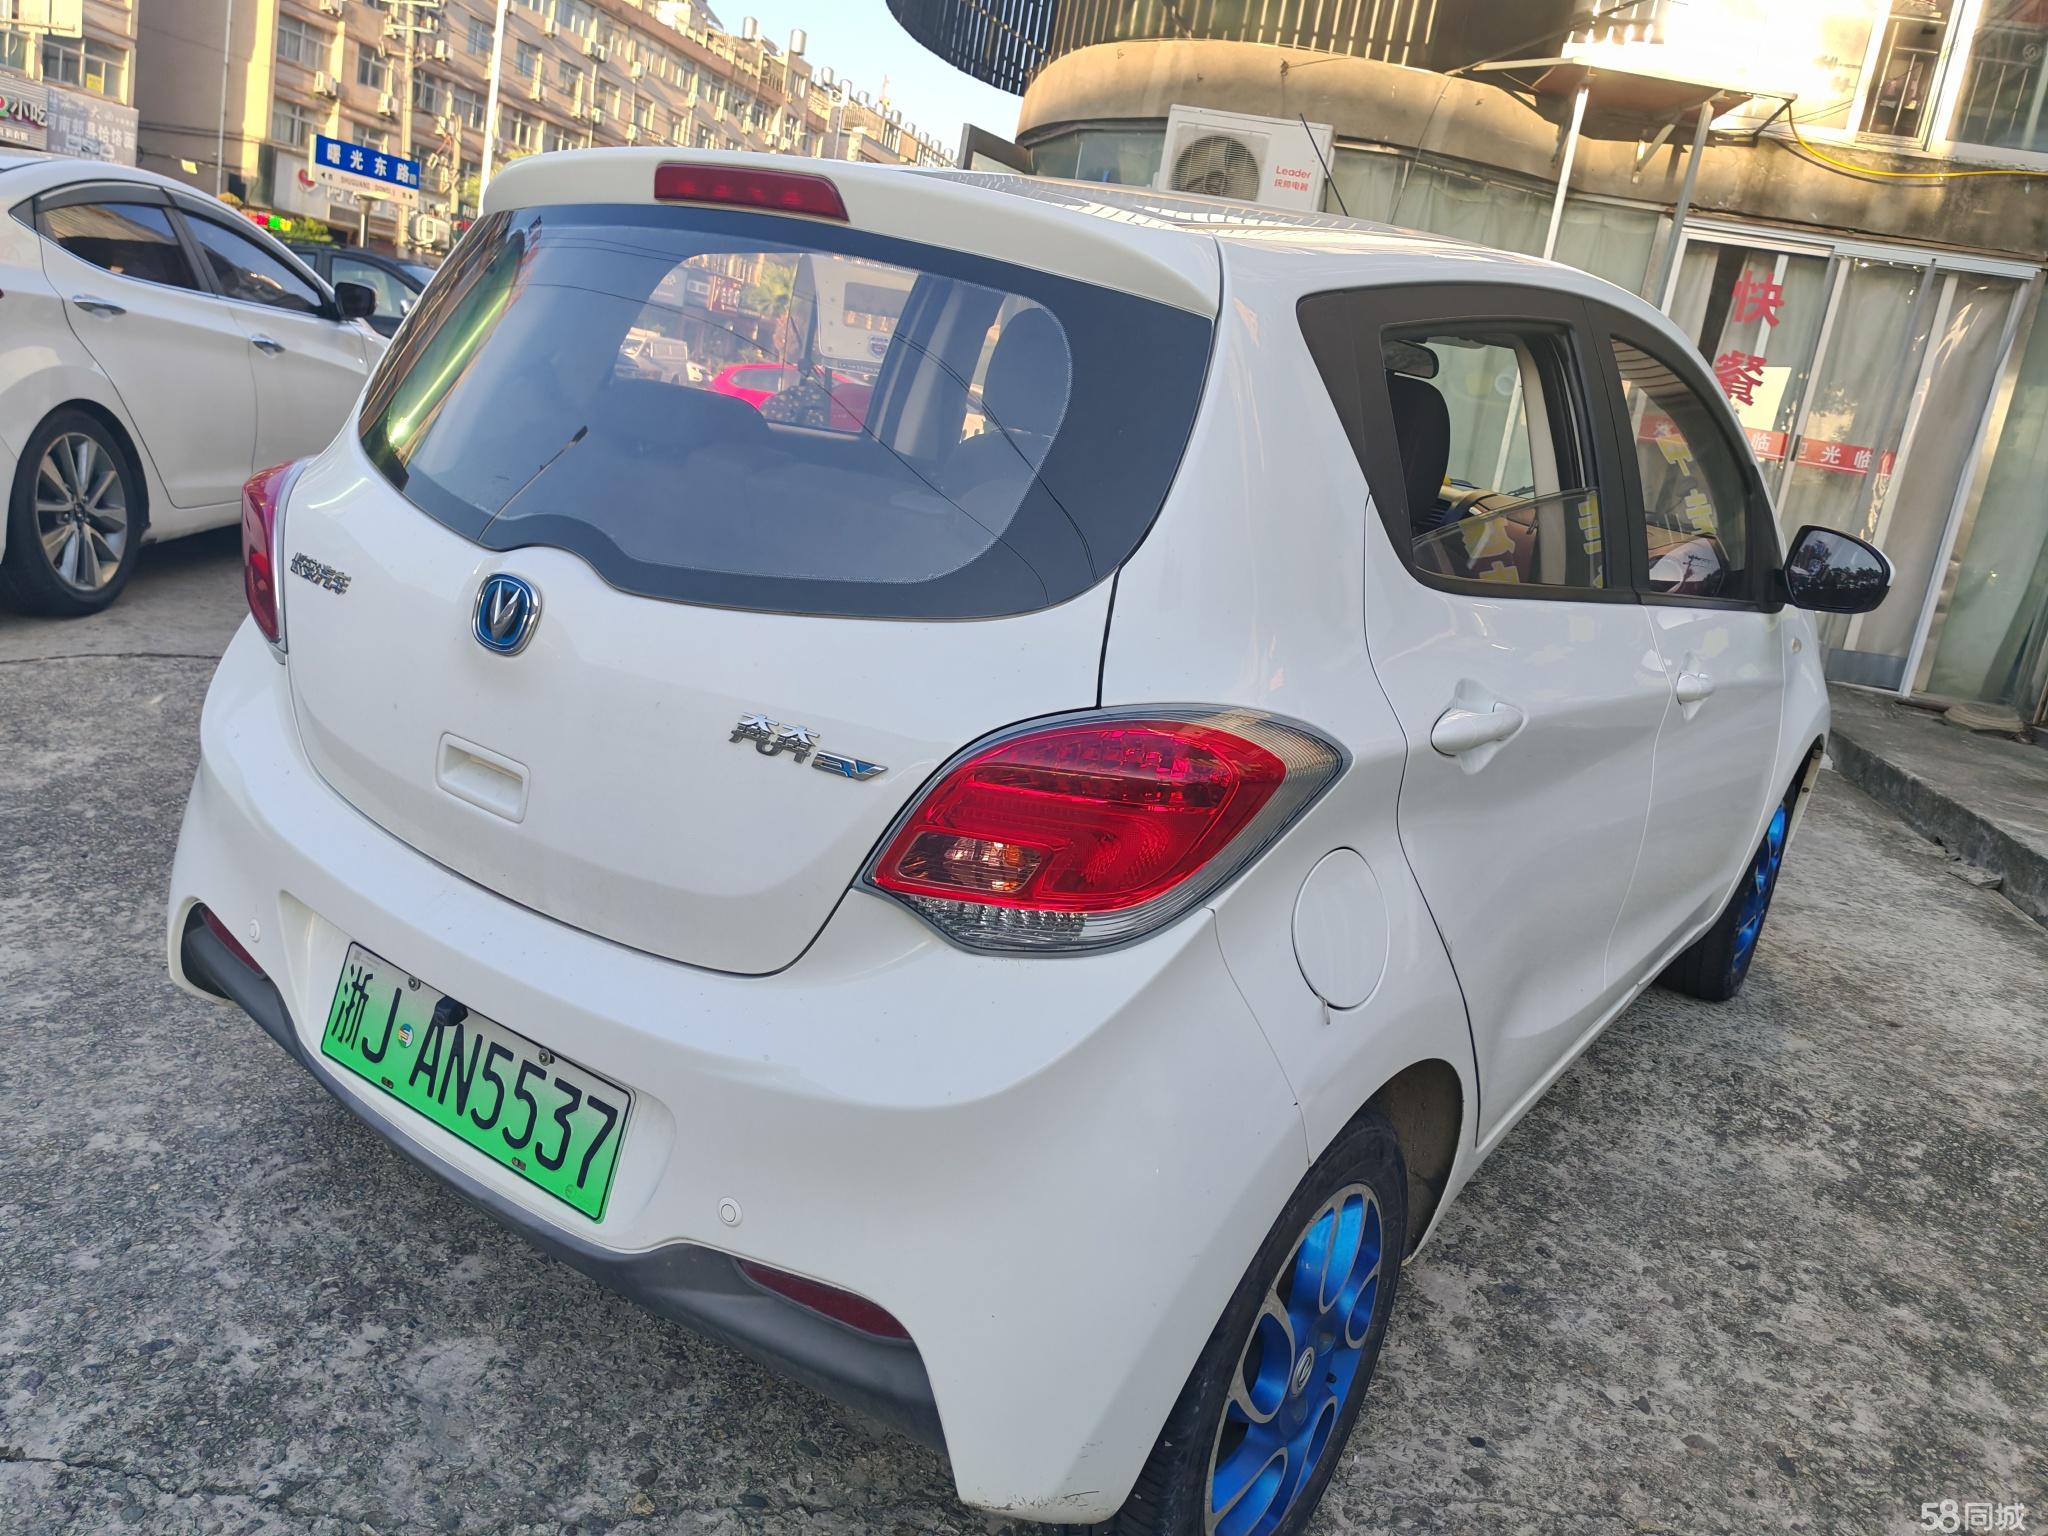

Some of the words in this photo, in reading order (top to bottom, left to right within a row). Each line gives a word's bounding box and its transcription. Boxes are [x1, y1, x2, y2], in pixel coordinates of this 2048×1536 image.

[9, 97, 48, 128] 小吃
[326, 142, 410, 183] 曙光东路
[1275, 165, 1312, 179] Leader
[1715, 270, 1785, 407] 快餐
